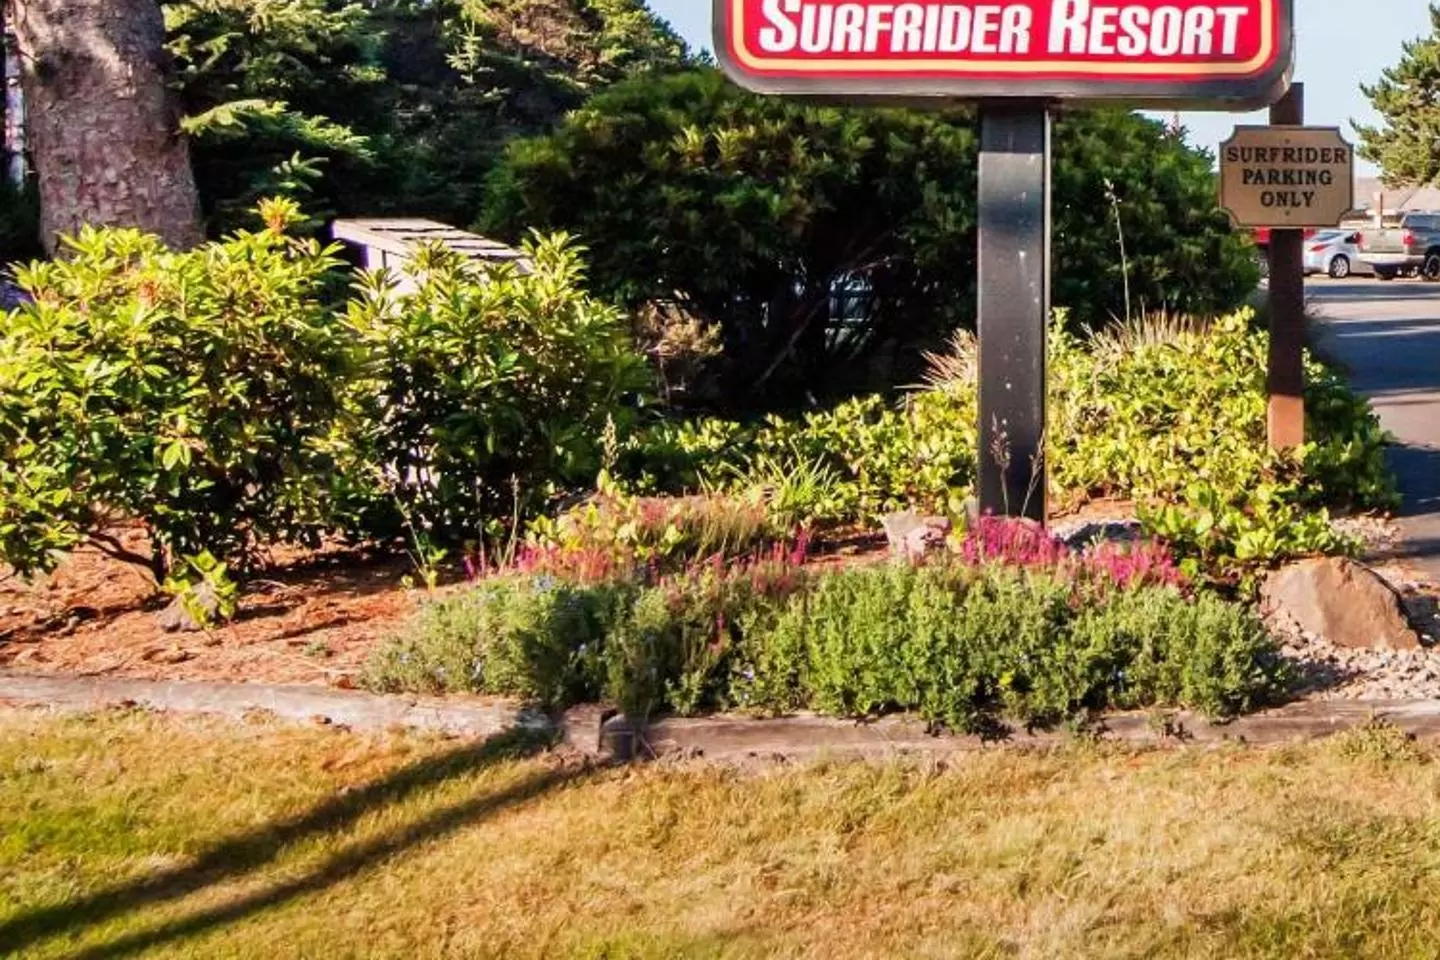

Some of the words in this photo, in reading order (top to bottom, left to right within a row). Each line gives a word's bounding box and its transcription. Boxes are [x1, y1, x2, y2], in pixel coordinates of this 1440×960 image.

[1228, 147, 1346, 164] SURFRIDER
[1243, 169, 1332, 185] PARKING
[1260, 192, 1314, 207] ONLY
